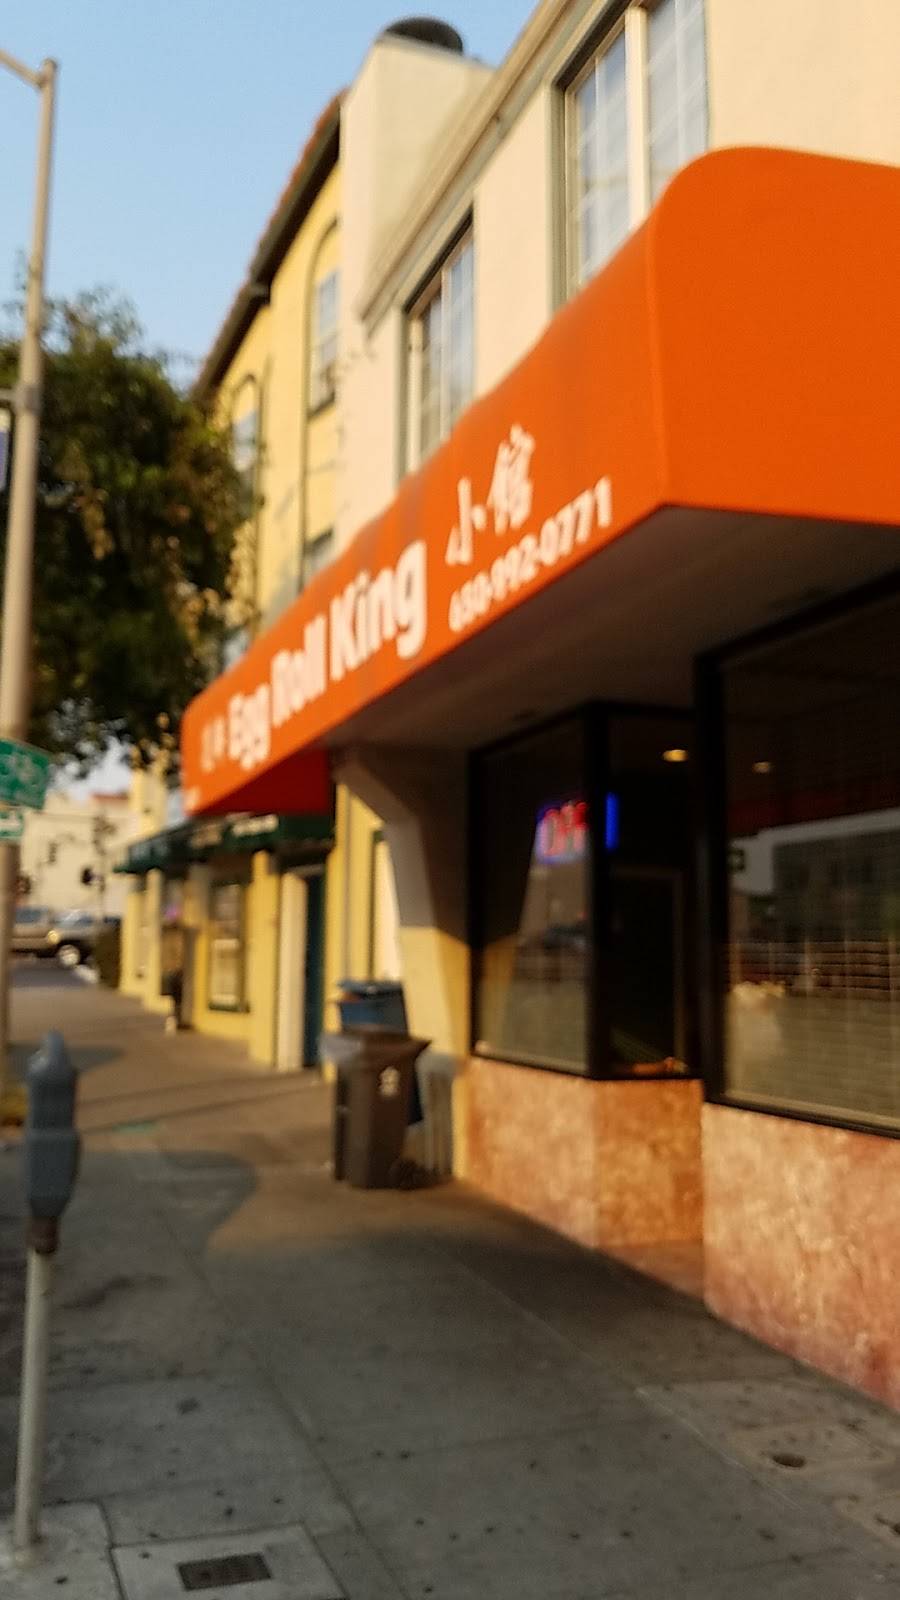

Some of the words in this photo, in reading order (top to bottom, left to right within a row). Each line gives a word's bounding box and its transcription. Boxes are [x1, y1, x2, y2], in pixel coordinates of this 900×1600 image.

[227, 683, 271, 771] Egg
[271, 614, 327, 728] Roll
[330, 540, 427, 681] King
